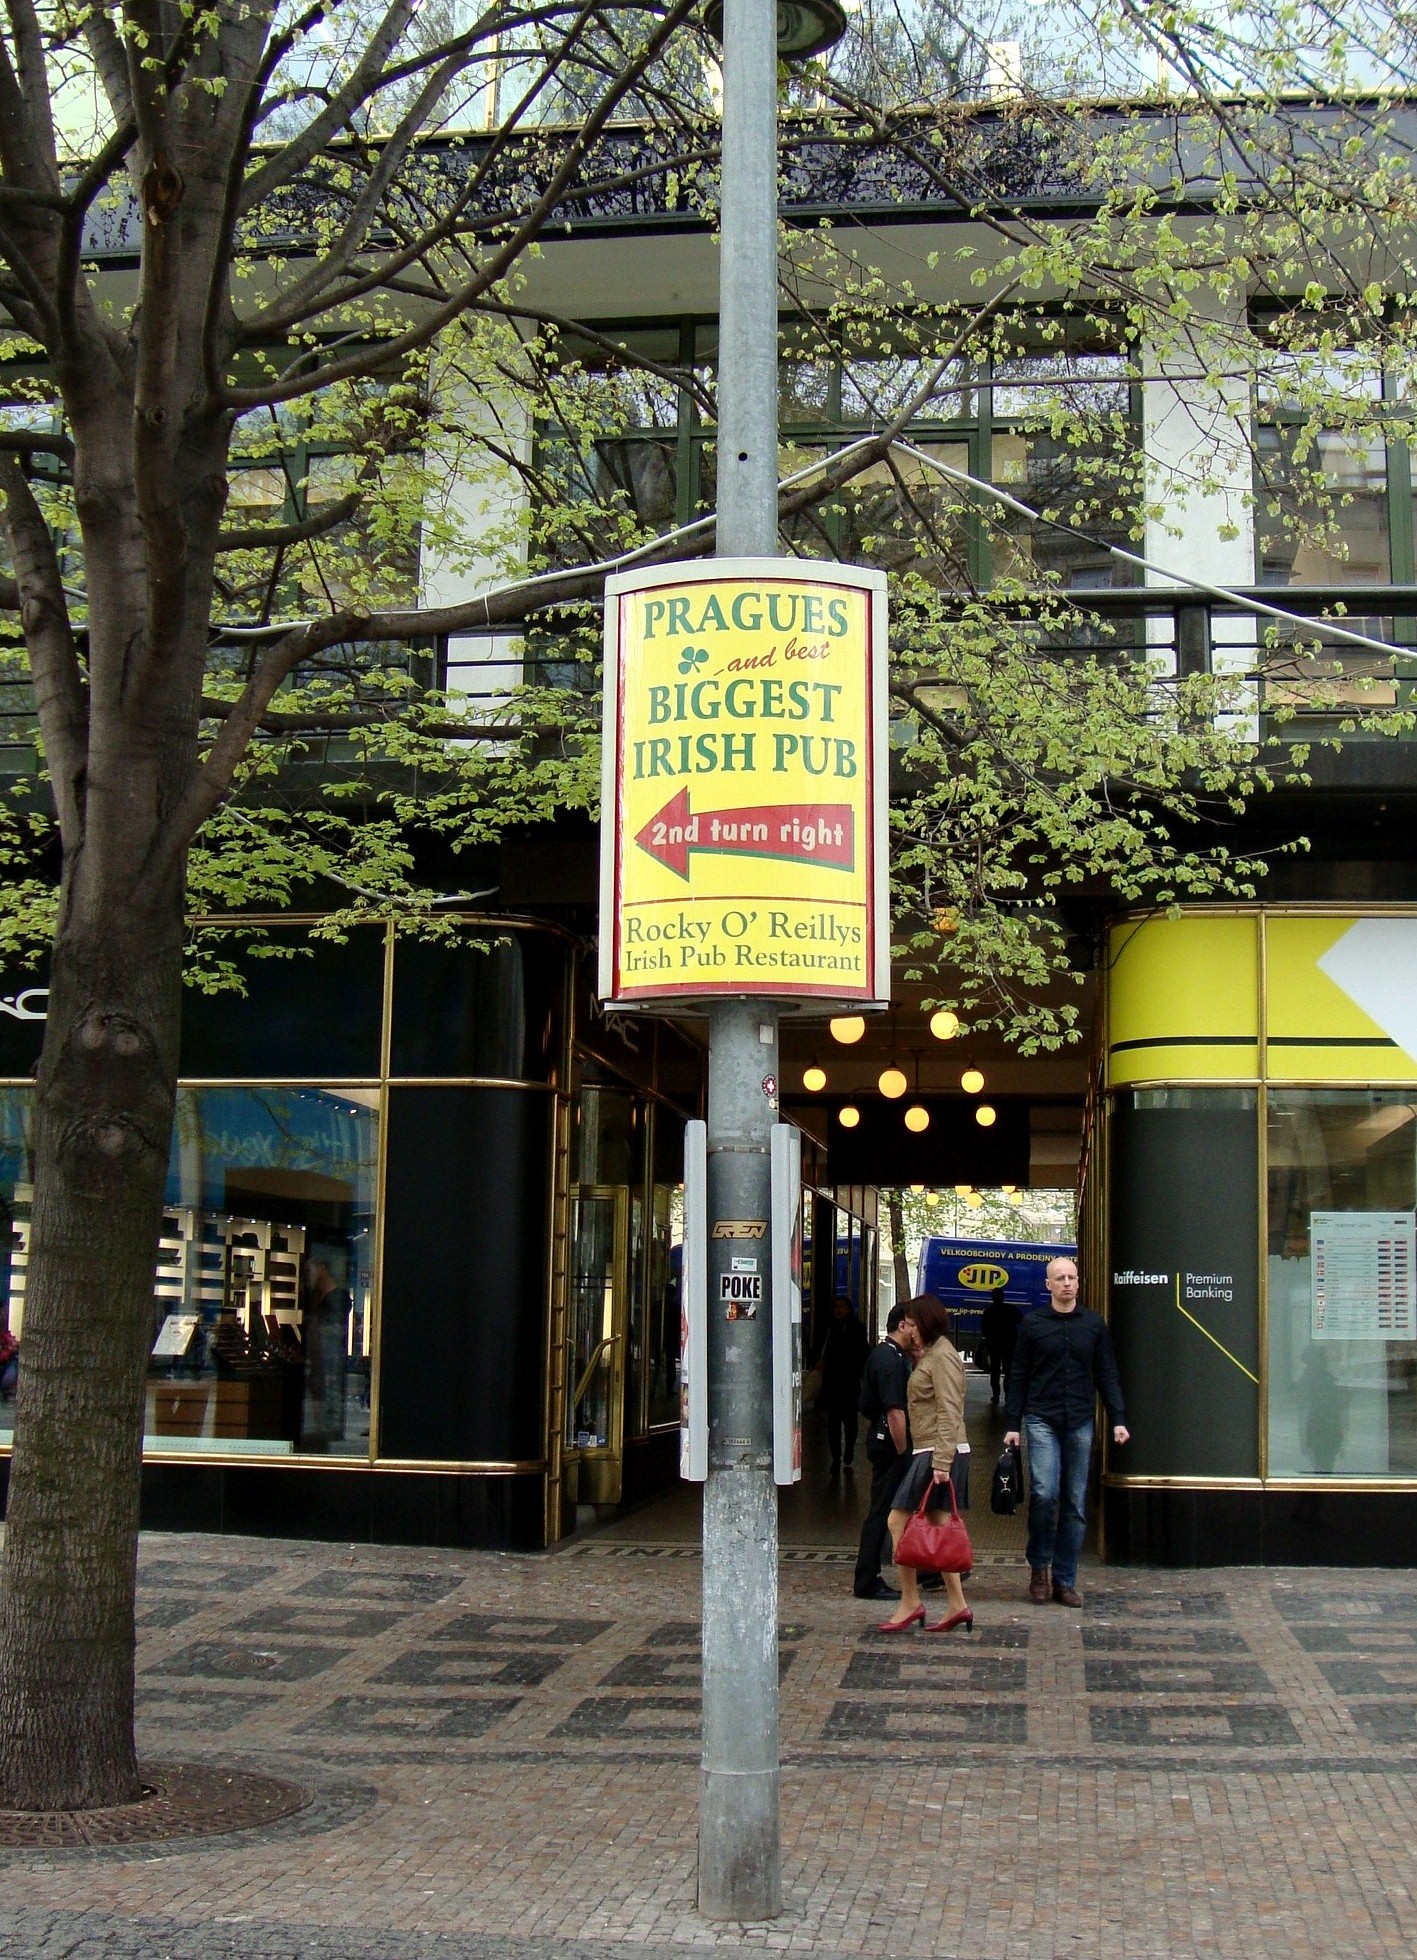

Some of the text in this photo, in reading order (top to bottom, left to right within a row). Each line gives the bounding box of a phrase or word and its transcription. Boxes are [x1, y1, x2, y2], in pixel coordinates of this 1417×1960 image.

[643, 592, 848, 640] PRAGUES
[714, 636, 831, 676] and best
[647, 678, 842, 725] BIGGEST
[632, 732, 858, 780] IRISH PUB
[651, 816, 844, 851] 2nd turn right
[625, 911, 712, 944] Rocky
[768, 911, 861, 947] Reillys
[625, 944, 861, 972] Irish Pub Restaurant
[940, 1247, 1007, 1260] VELKOOBCHODY
[1007, 1252, 1014, 1260] A
[721, 1275, 761, 1299] POKE
[966, 1269, 1002, 1285] JIP
[1113, 1270, 1169, 1285] Raiffeisen
[1186, 1272, 1233, 1285] Premium
[1186, 1285, 1233, 1302] Banking
